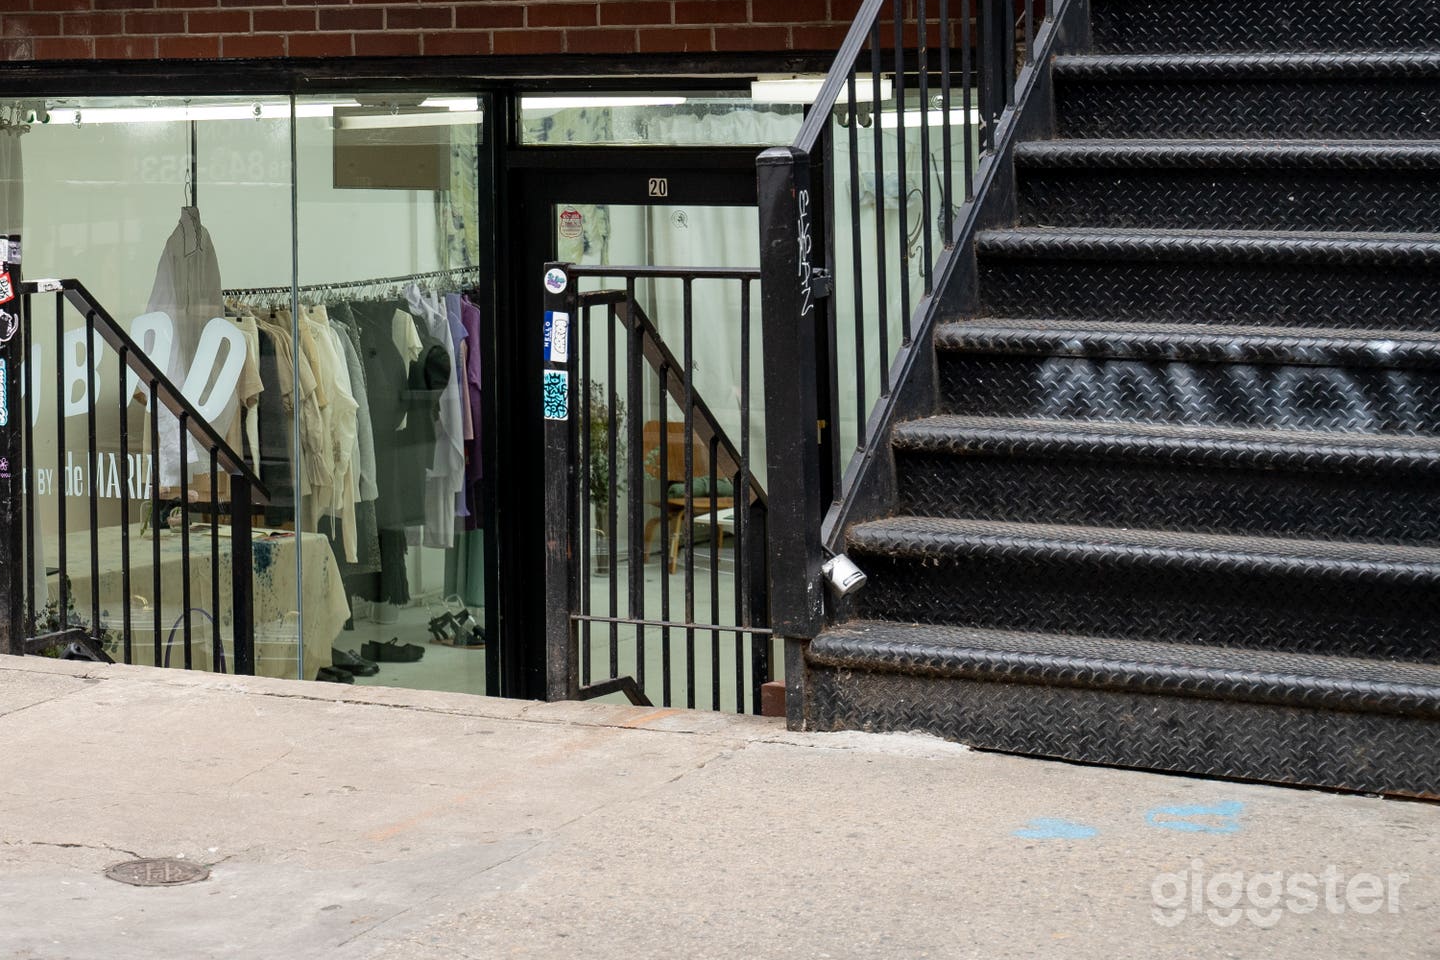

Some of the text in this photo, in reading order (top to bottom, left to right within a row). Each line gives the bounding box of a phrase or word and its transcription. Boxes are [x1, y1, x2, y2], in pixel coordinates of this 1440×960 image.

[650, 179, 666, 196] 20
[37, 468, 54, 496] BY
[64, 451, 84, 497] de
